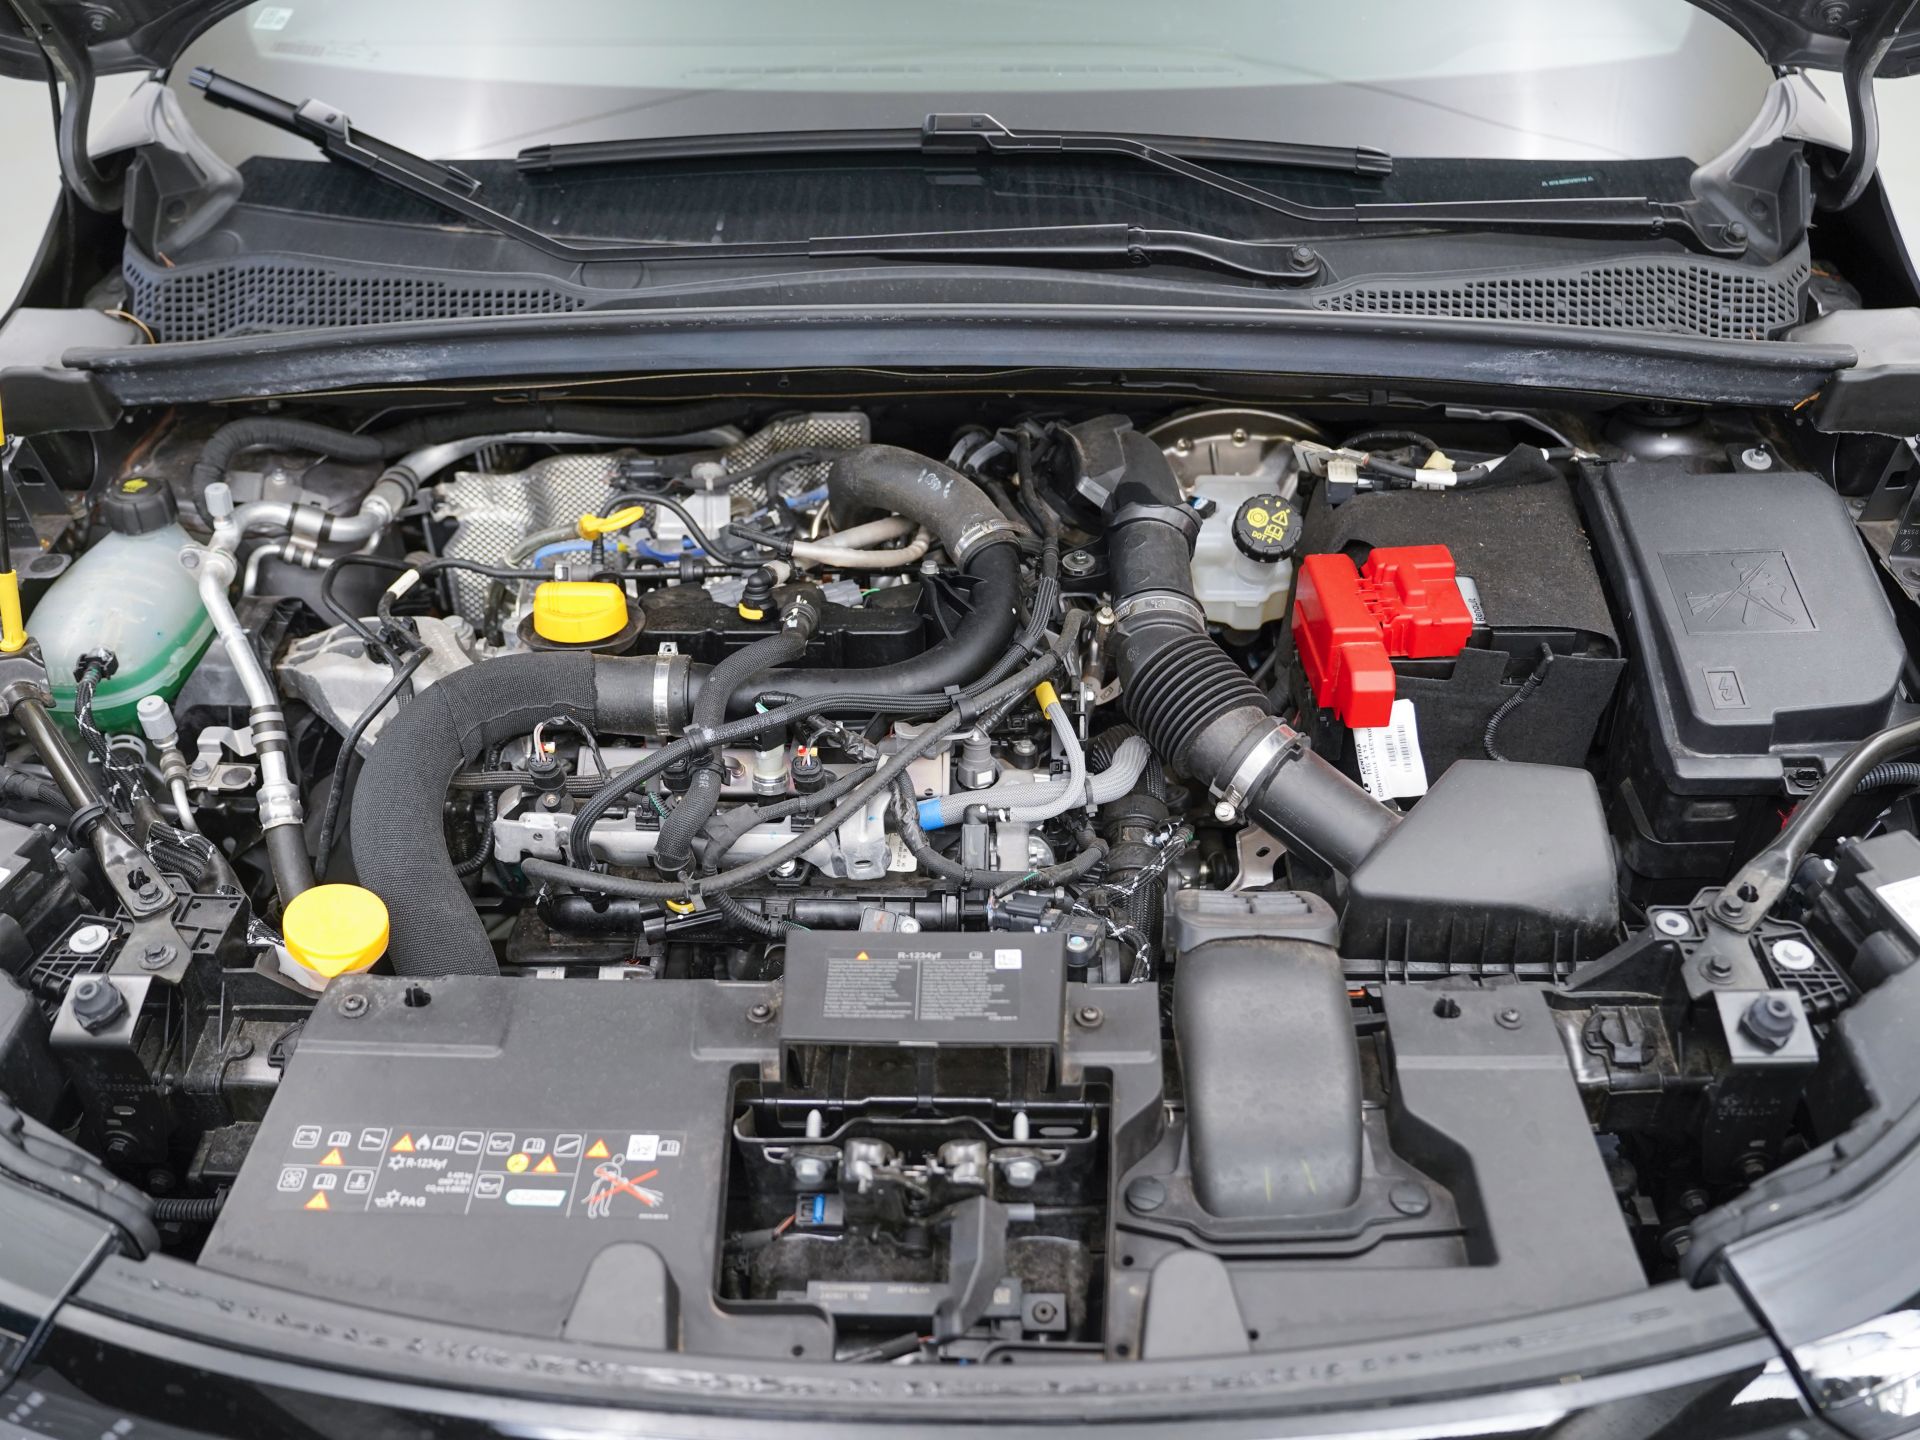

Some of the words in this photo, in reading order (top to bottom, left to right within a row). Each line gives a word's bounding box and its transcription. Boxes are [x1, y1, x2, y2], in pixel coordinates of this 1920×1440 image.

[1251, 530, 1267, 541] DOT
[1468, 598, 1486, 622] Renault
[897, 951, 942, 961] R-1234yf
[405, 1157, 449, 1171] R-1234yf
[400, 1195, 426, 1207] PAG
